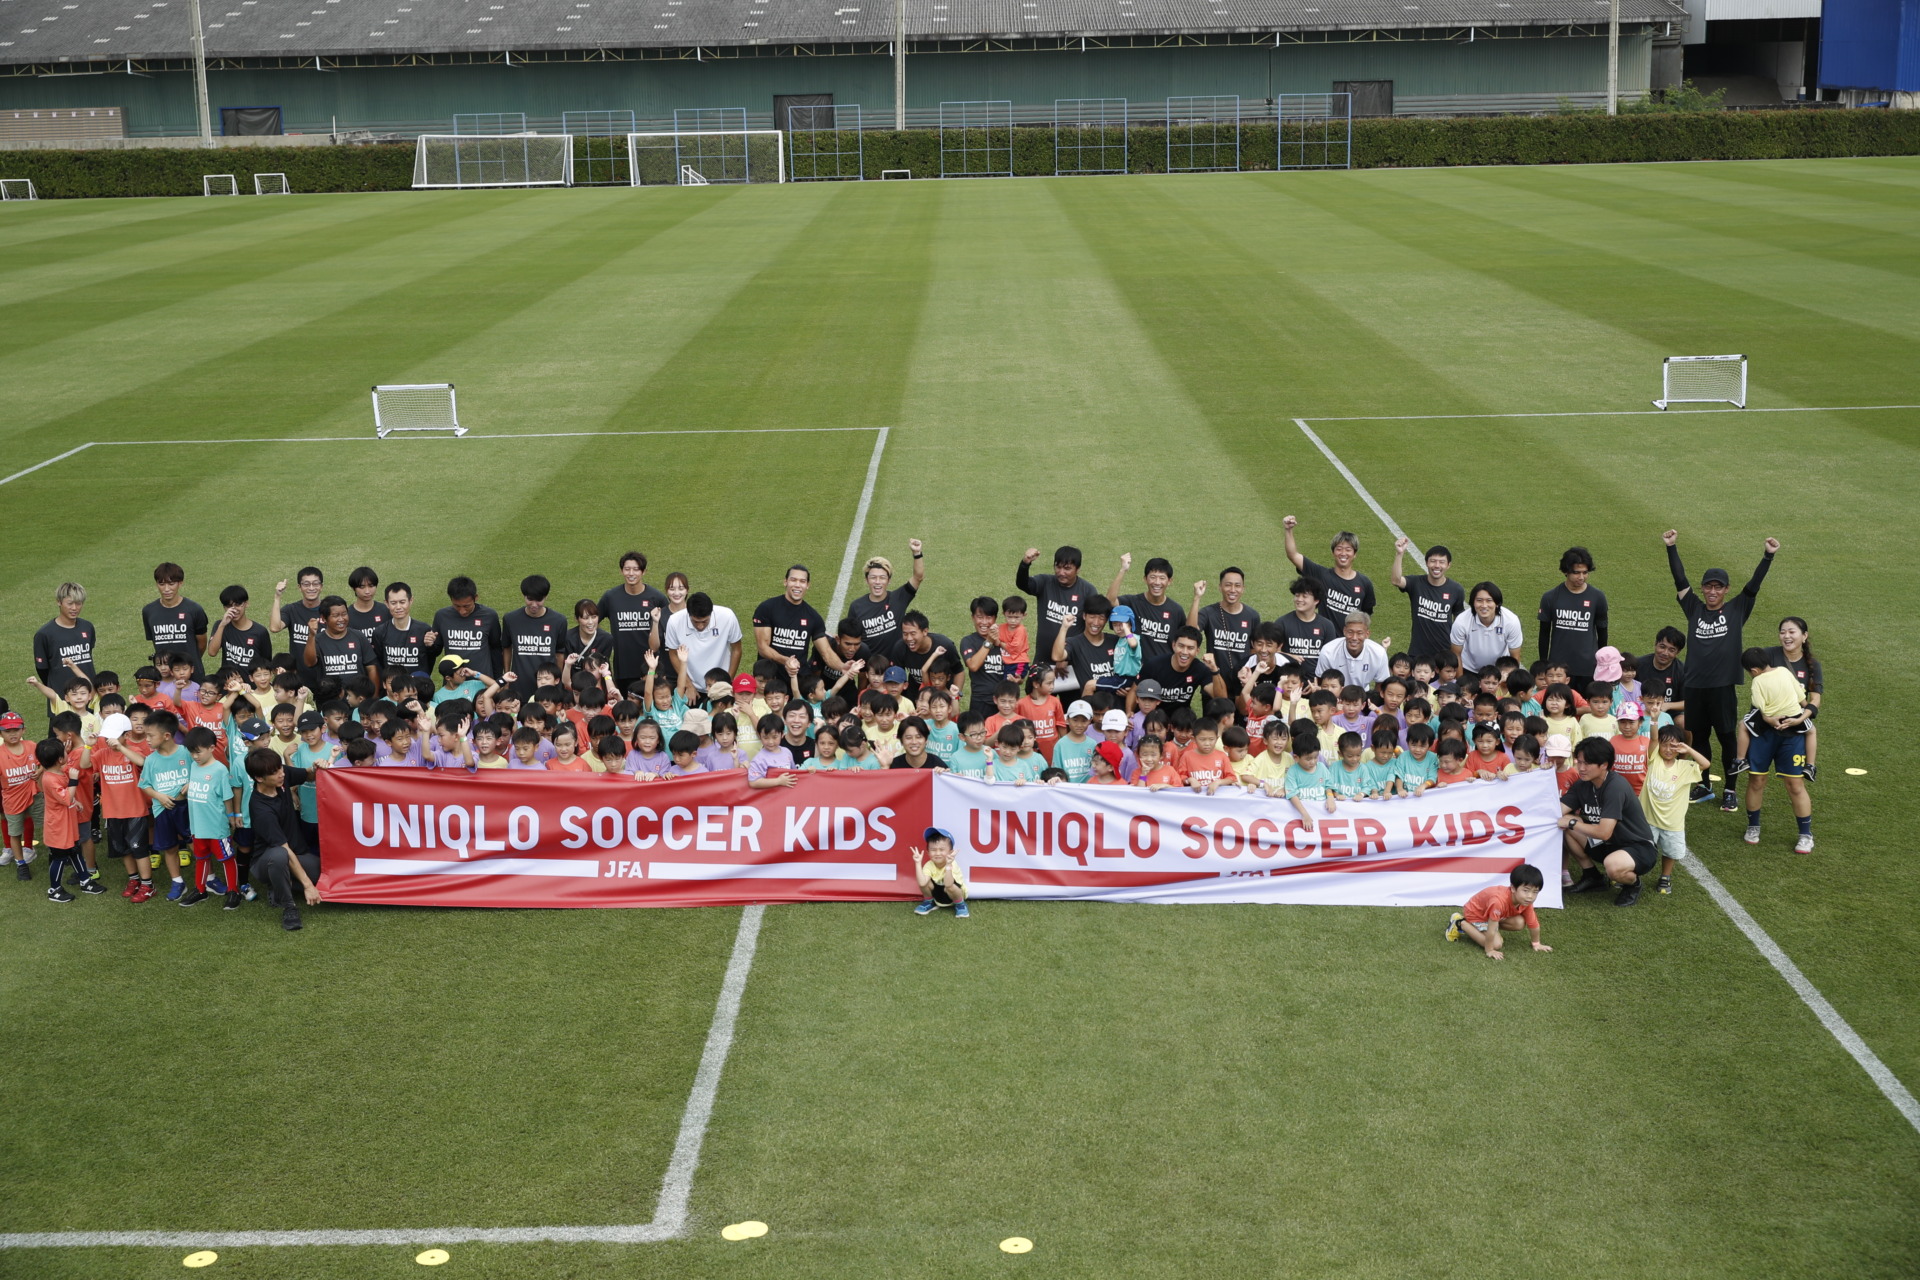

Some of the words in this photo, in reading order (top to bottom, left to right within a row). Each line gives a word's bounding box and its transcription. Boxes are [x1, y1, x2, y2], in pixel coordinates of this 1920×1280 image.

[1327, 588, 1360, 606] UNIQLO
[1047, 599, 1078, 615] UNIQLO
[1327, 598, 1346, 610] SOCCER
[1418, 596, 1450, 612] UNIQLO
[617, 611, 650, 622] UNIQLO
[1418, 607, 1437, 618] SOCCER
[1556, 609, 1591, 621] UNIQLO
[862, 611, 894, 628] UNIQLO
[1556, 619, 1576, 627] SOCCER
[153, 623, 187, 635] UNIQLO
[865, 624, 884, 635] SOCCER
[885, 620, 896, 629] KIDS
[1715, 625, 1728, 633] KIDS
[448, 630, 482, 641] UNIQLO
[774, 627, 808, 641] UNIQLO
[1214, 629, 1248, 642] UNIQLO
[517, 635, 551, 646] UNIQLO
[772, 636, 793, 645] SOCCER
[1214, 640, 1234, 648] SOCCER
[1289, 637, 1321, 649] UNIQLO
[59, 643, 90, 656] UNIQLO
[385, 646, 418, 657] UNIQLO
[324, 654, 357, 665] UNIQLO
[985, 654, 1002, 665] NIQ
[1090, 661, 1114, 673] UNIQL
[6, 762, 36, 777] UNIQLO
[102, 764, 132, 774] UNIQLO
[155, 768, 188, 782] UNIQLO
[157, 780, 176, 788] SOCCER
[1300, 786, 1325, 797] NIQLO
[352, 802, 540, 859] UNIQLO
[559, 805, 762, 853] SOCCER
[783, 806, 896, 852] KIDS
[969, 808, 1160, 866] UNIQLO
[1182, 815, 1387, 860] SOCCER
[1409, 805, 1525, 847] KIDS
[603, 860, 644, 879] JFA
